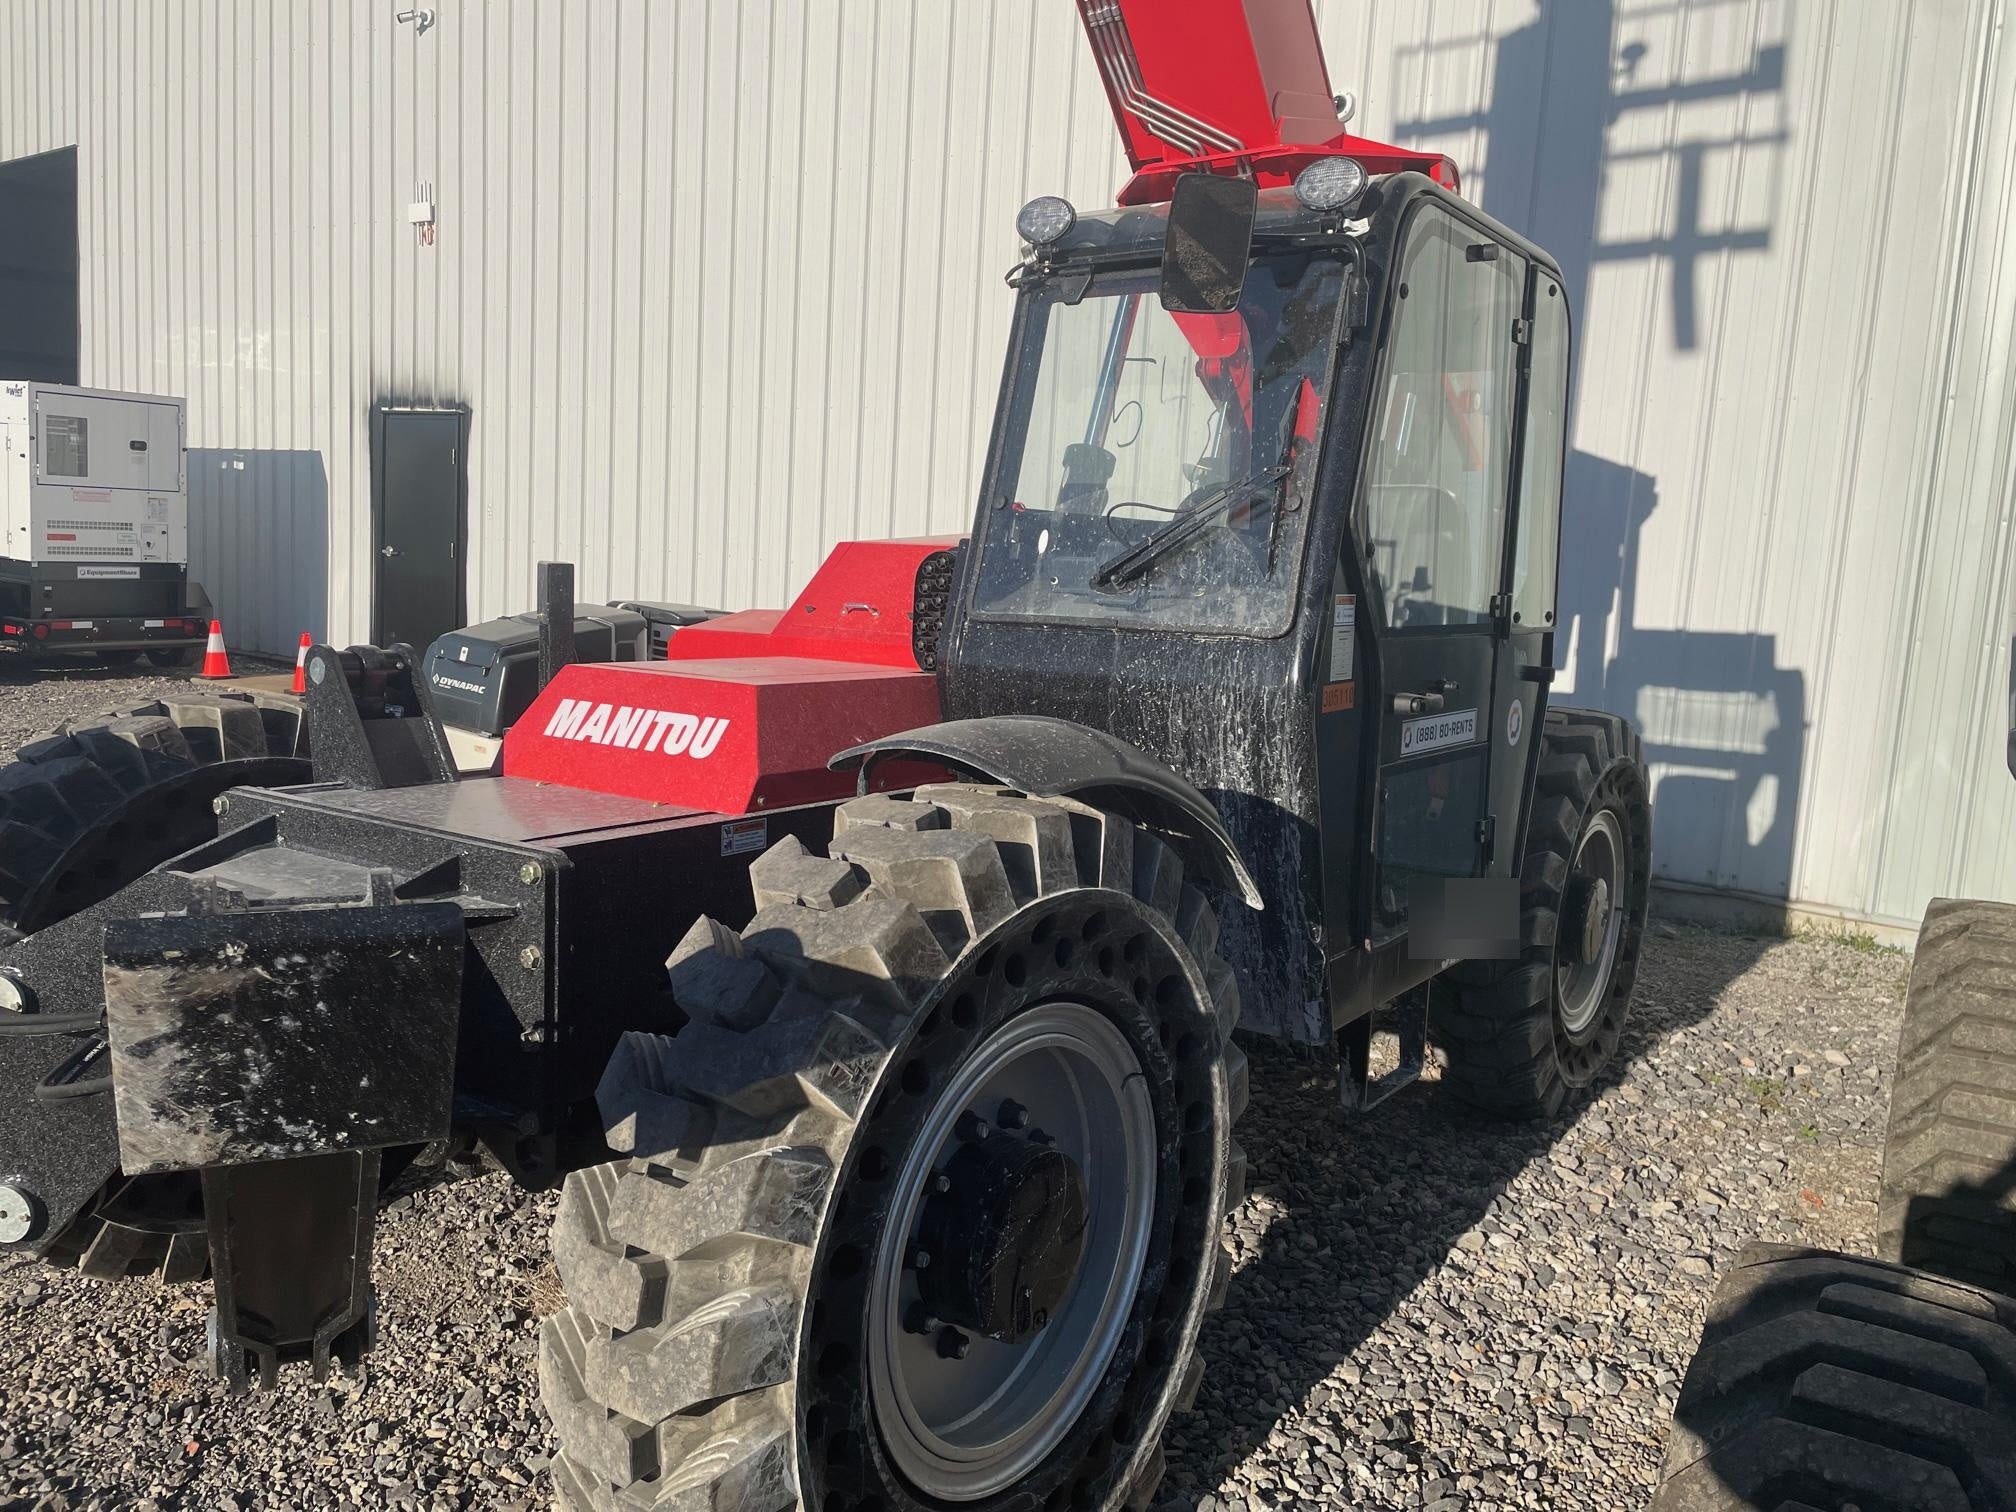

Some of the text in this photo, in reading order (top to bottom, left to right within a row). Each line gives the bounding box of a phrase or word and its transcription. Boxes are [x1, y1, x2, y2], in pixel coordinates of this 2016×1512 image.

[439, 676, 486, 695] DYNAPAC
[543, 698, 730, 759] MANITOU
[1416, 718, 1473, 745] (888) 80-RENTS
